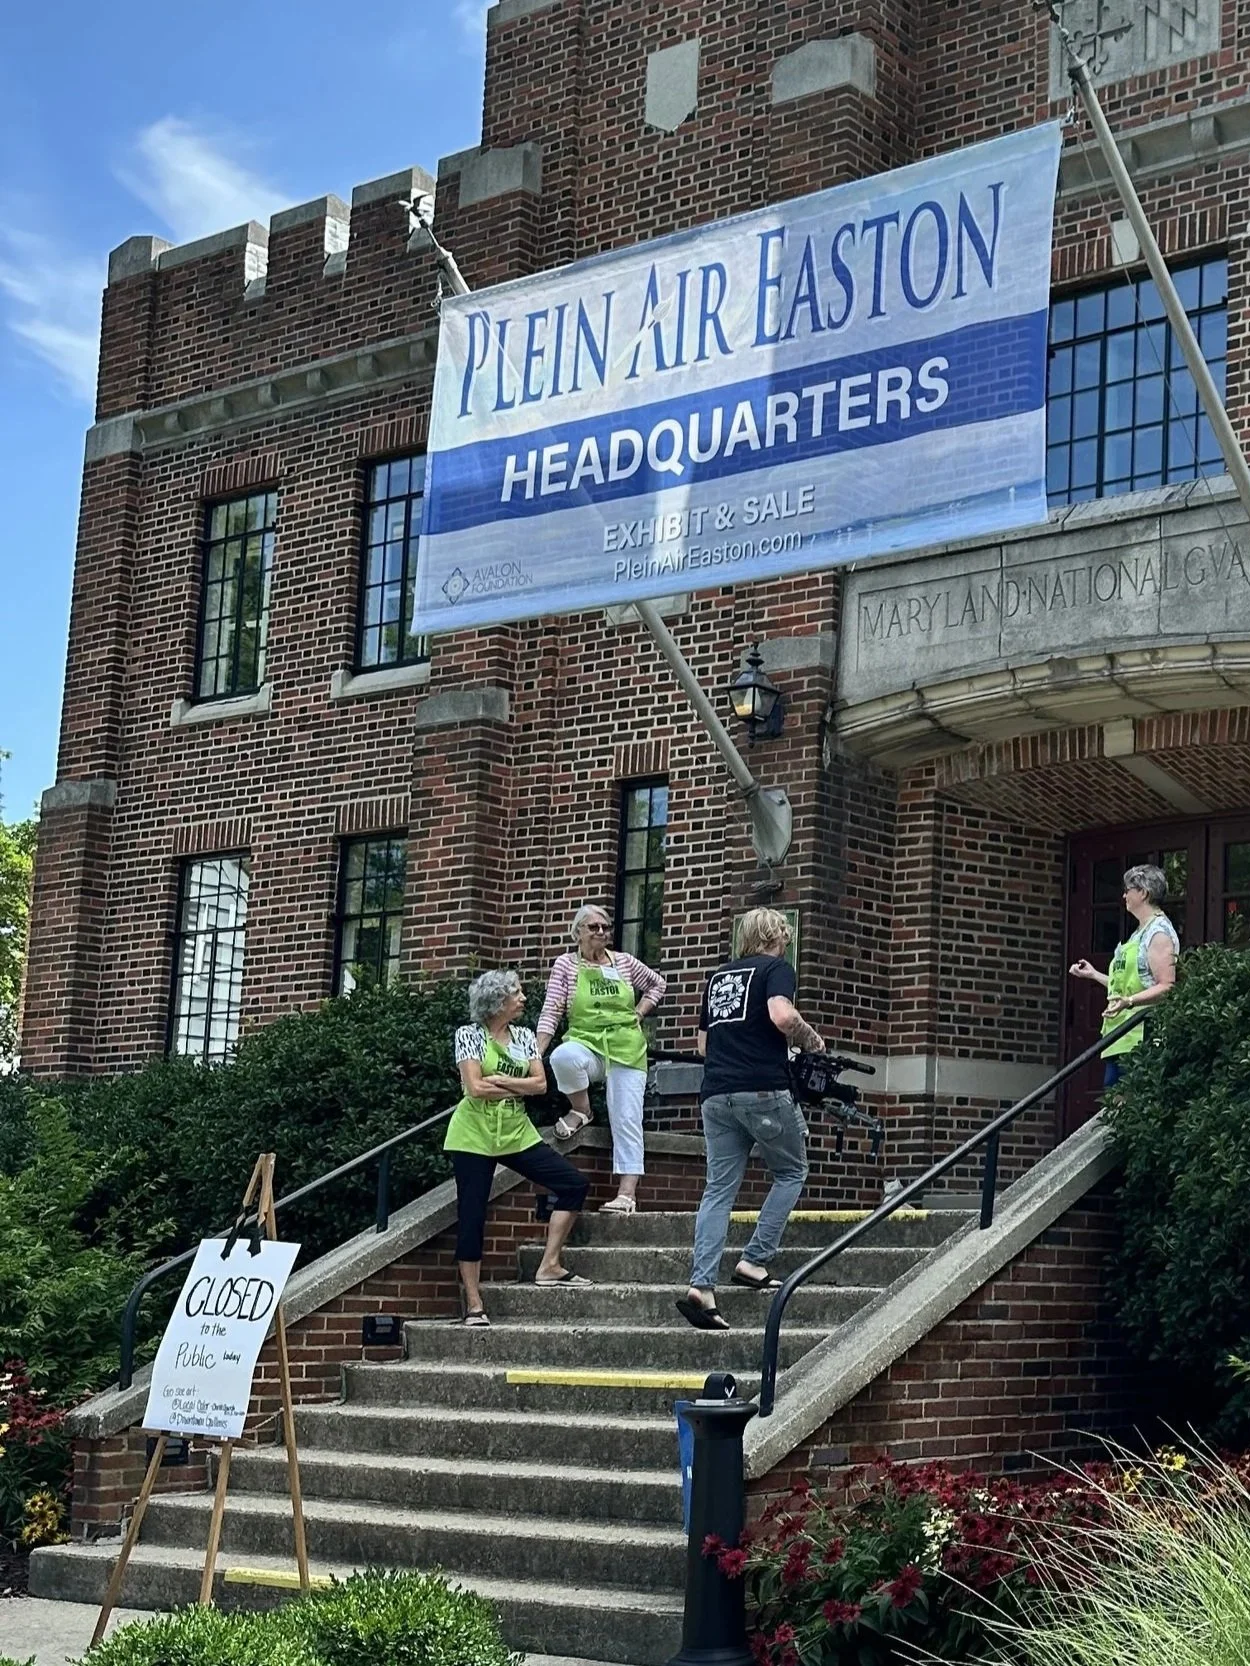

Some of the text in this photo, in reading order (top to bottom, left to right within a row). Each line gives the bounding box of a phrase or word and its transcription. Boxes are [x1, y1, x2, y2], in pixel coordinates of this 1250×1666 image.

[457, 181, 1006, 419] PLEIN AIR EASTON
[500, 355, 951, 503] HEADQUARTERS
[603, 484, 816, 553] EXHIBIT & SALE
[472, 560, 522, 583] AVALON
[613, 530, 803, 582] PleinAirEaston.com
[471, 574, 533, 594] FOUNDATION
[185, 1276, 275, 1322] CLOSED
[200, 1322, 227, 1336] to the
[174, 1341, 241, 1370] Public today
